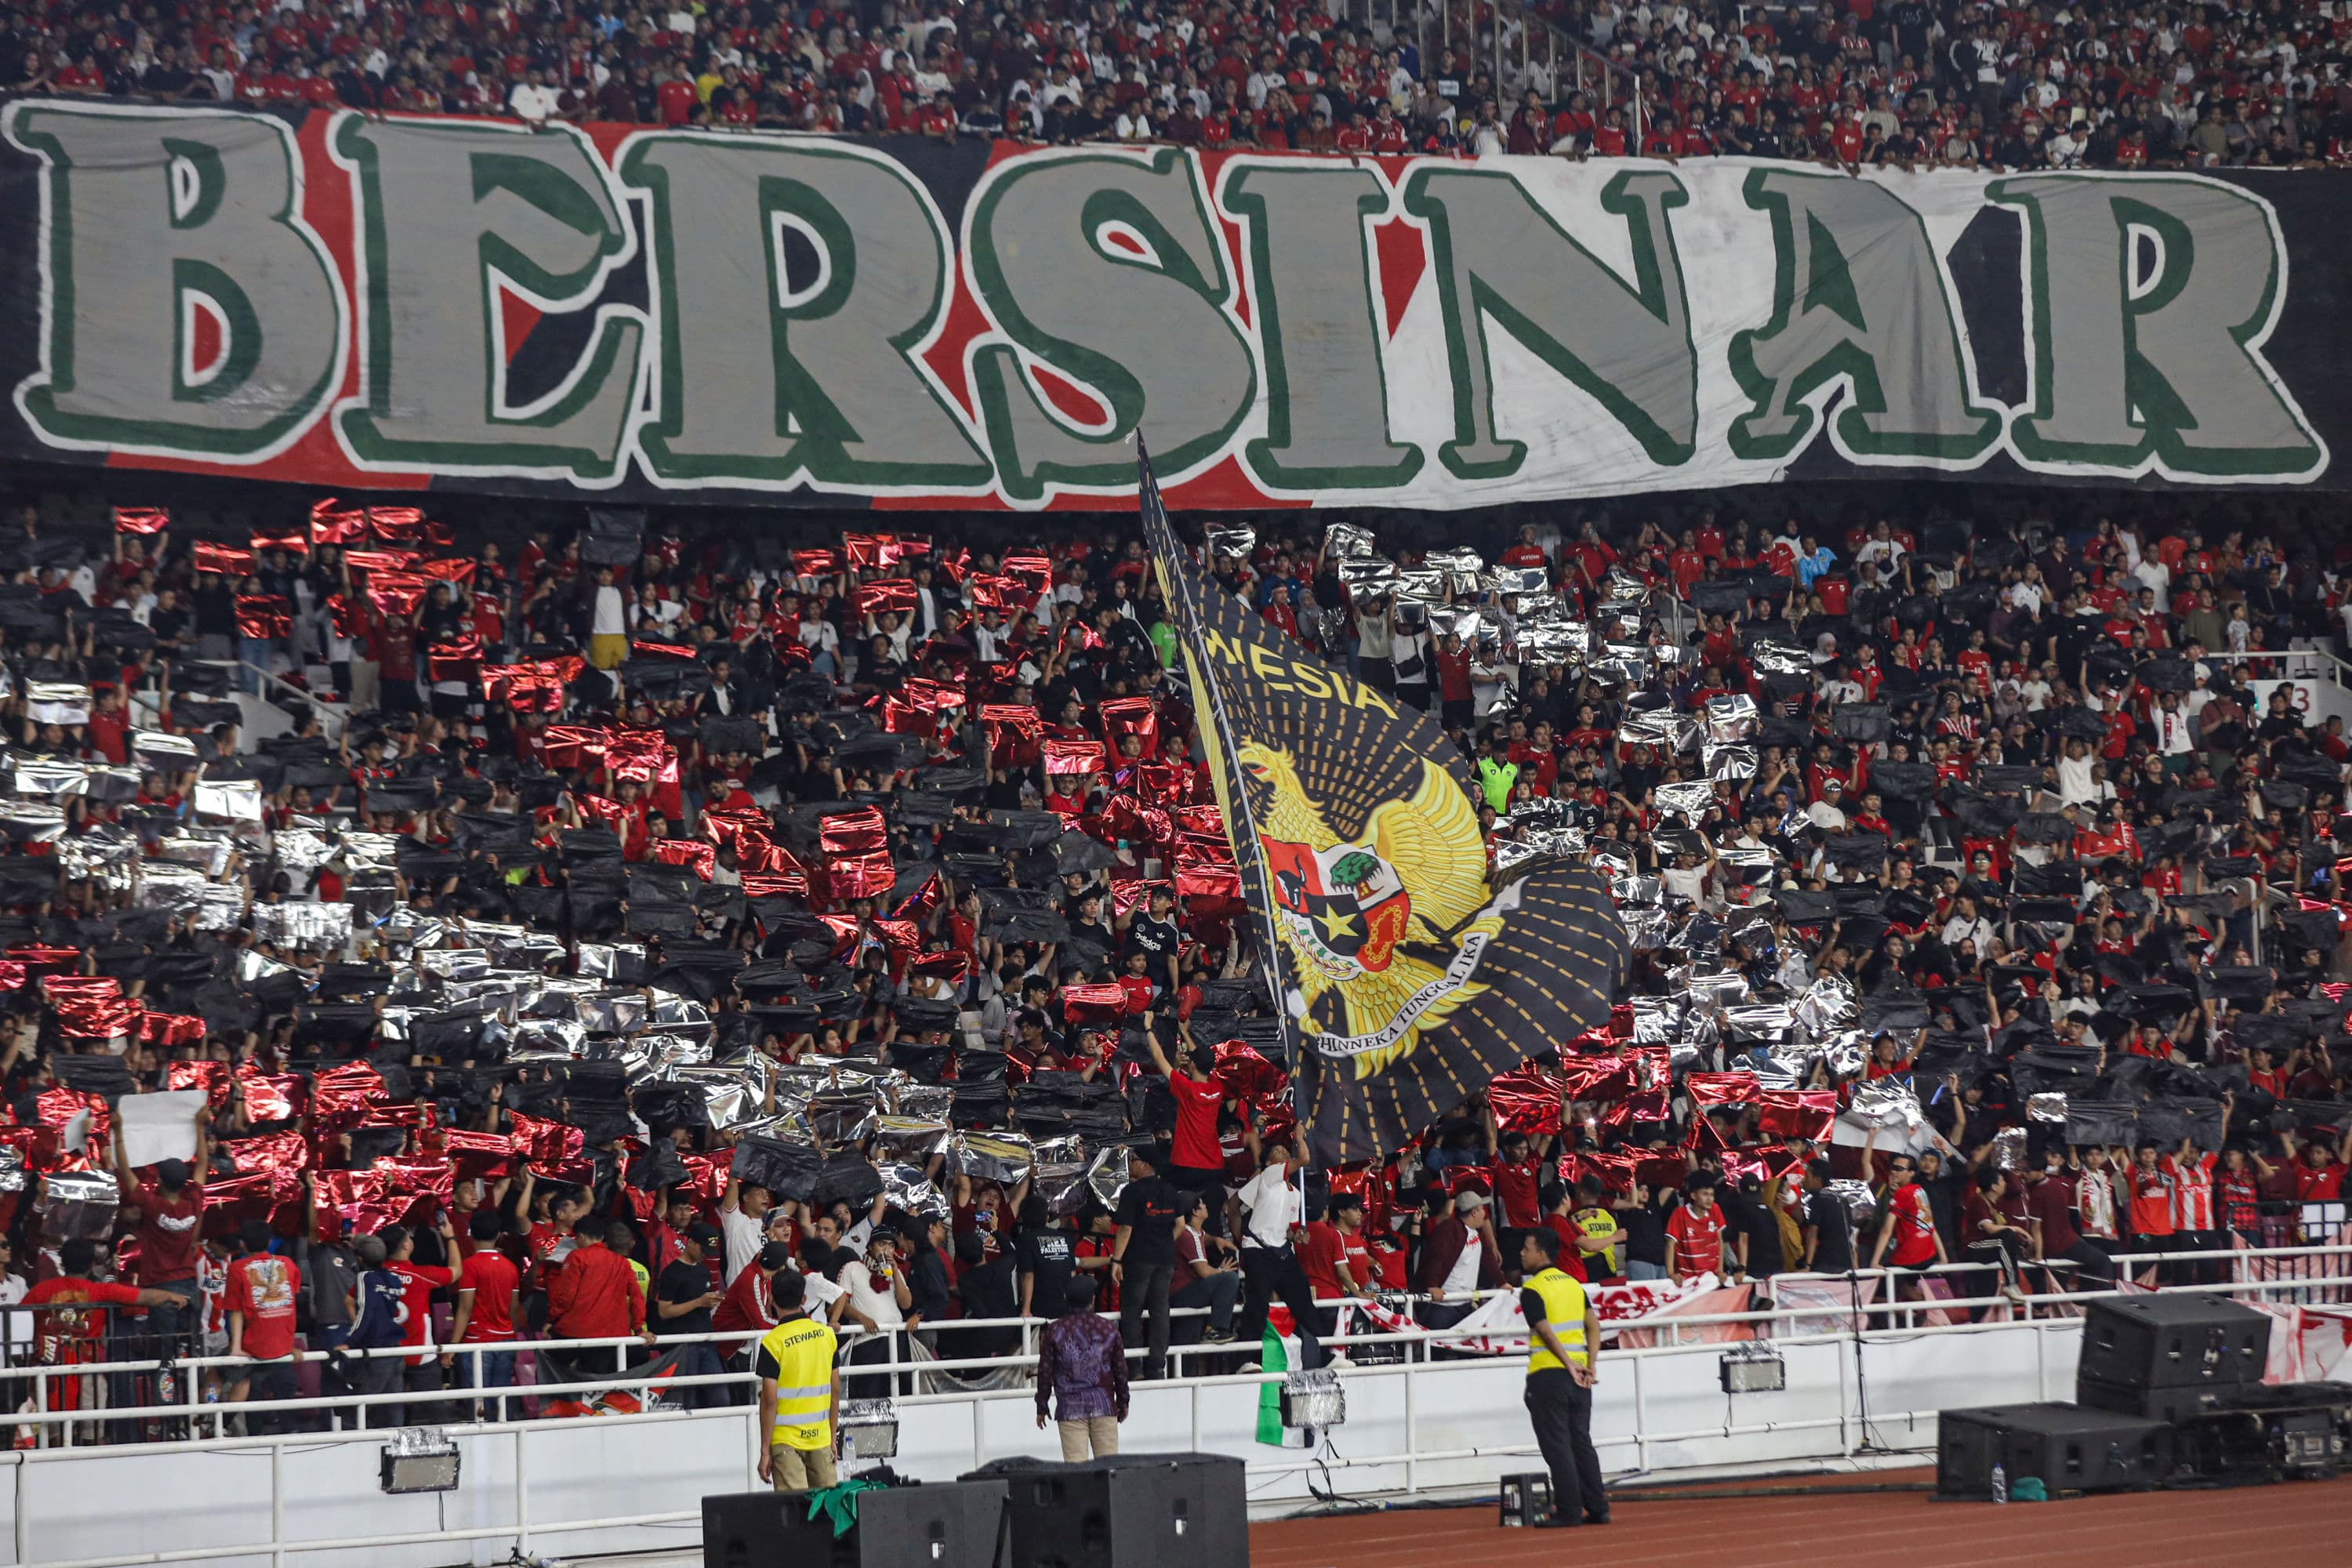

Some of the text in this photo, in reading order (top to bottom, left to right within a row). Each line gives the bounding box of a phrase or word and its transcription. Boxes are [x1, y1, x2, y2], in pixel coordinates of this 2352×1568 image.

[0, 100, 2331, 512] BERSINAR
[1134, 931, 1161, 951] adidas
[1317, 935, 1481, 1053] HINNEKA TUNGGAL IKA
[1588, 1223, 1613, 1232] STEWARD
[784, 1329, 825, 1348] STEWARD
[800, 1428, 819, 1438] PSSI
